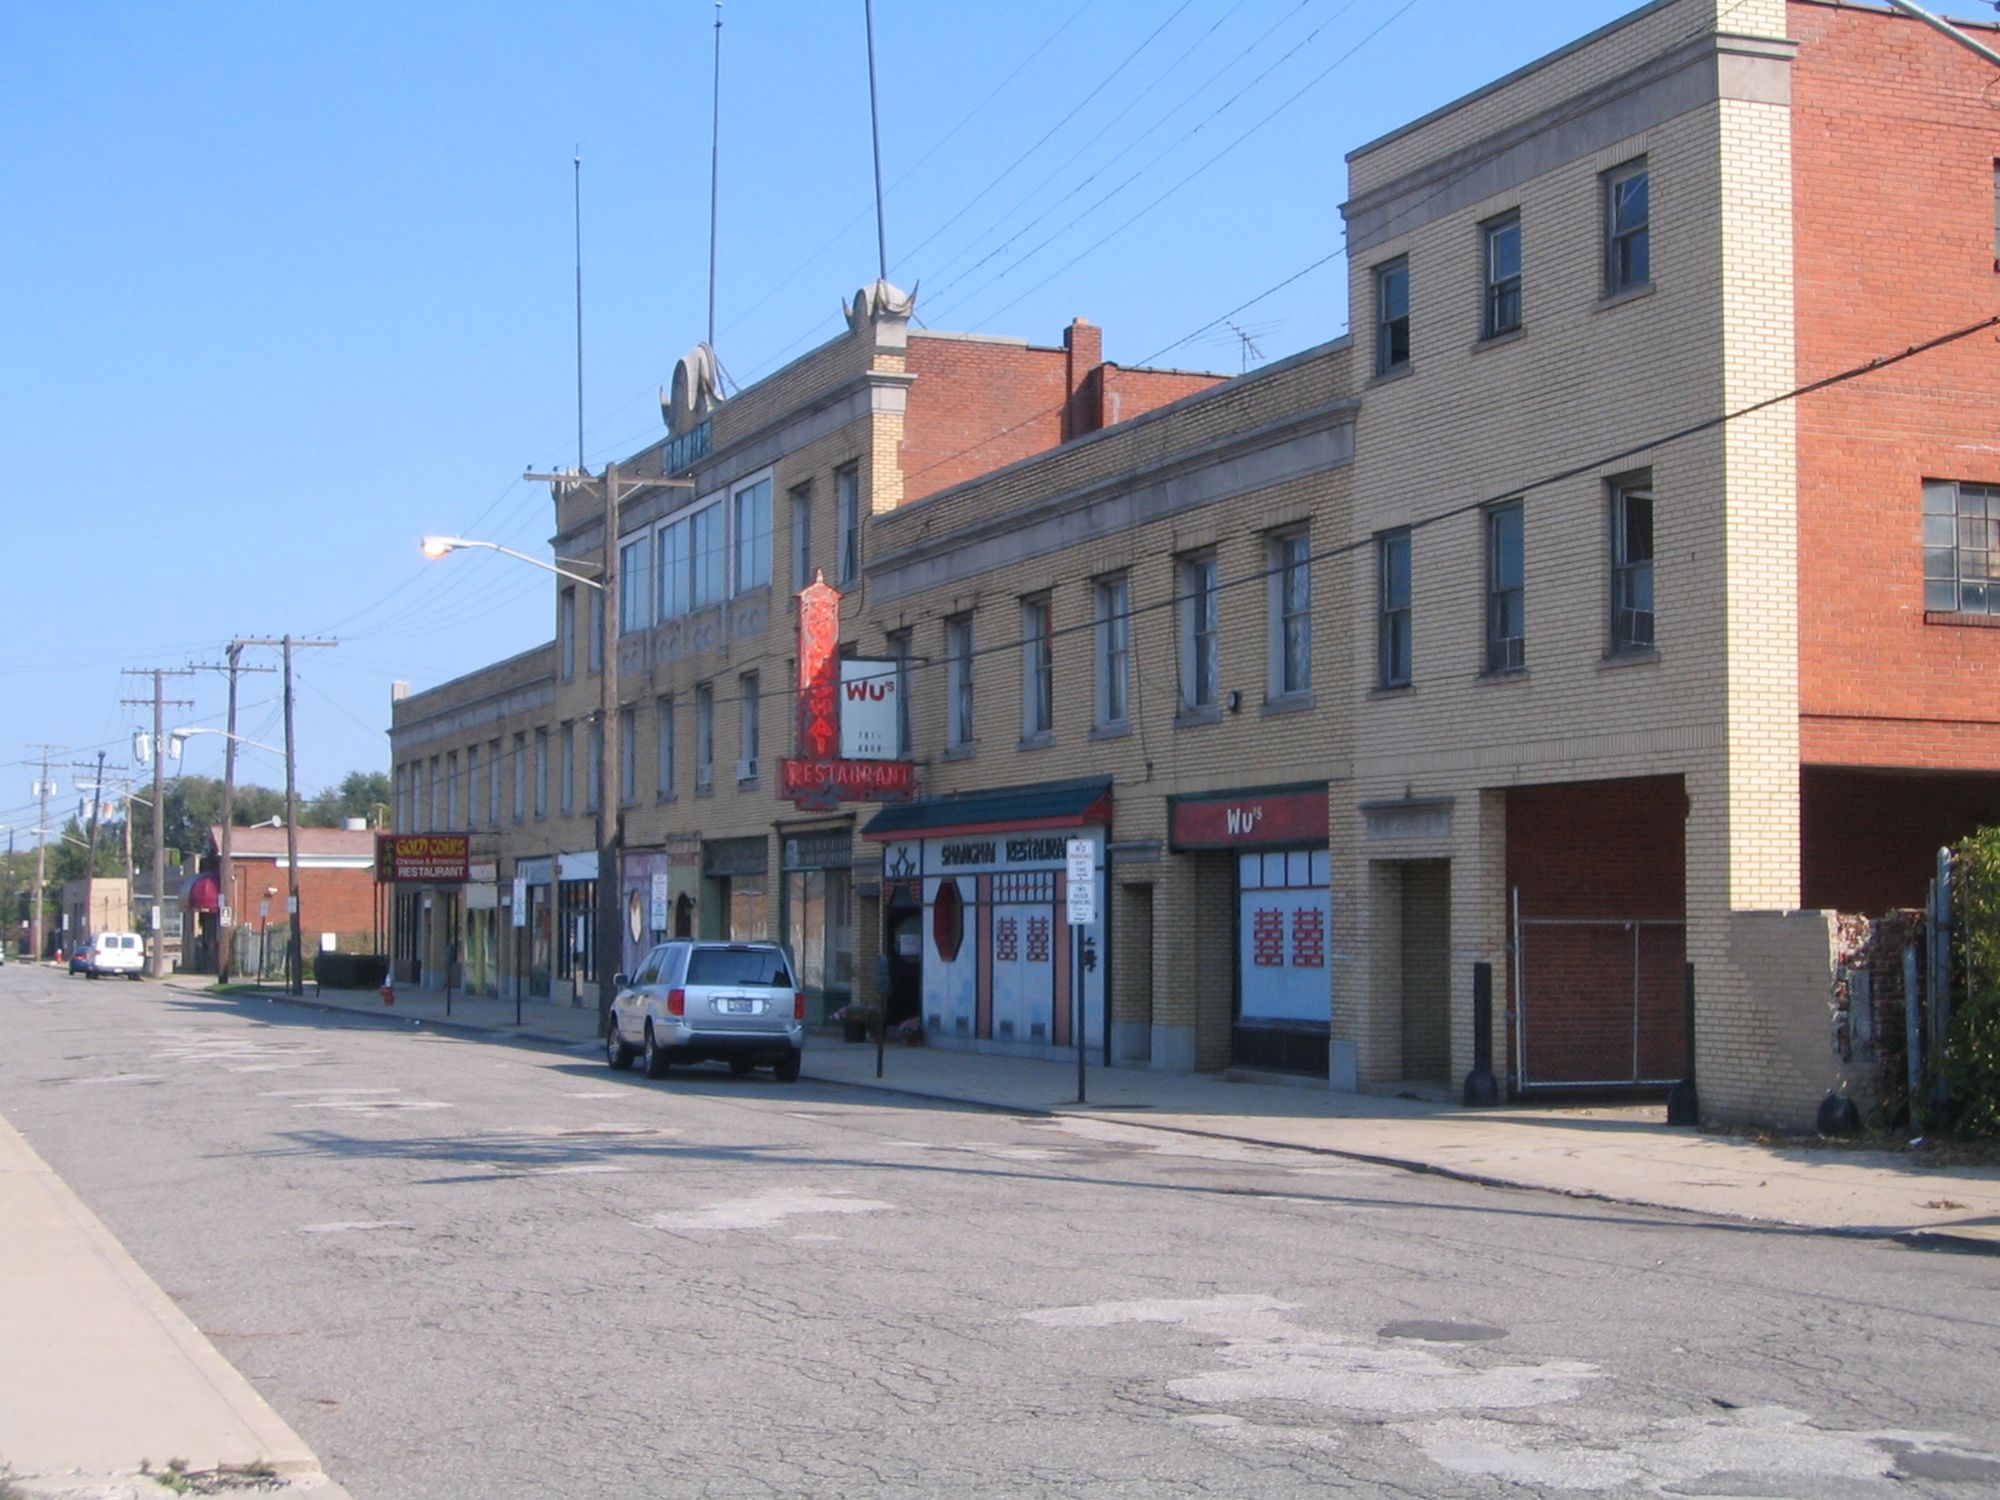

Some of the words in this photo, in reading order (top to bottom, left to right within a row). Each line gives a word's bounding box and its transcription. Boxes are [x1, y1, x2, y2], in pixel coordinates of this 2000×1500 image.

[787, 761, 908, 787] RESTAURANT
[941, 842, 996, 867] SHANGHAI
[1006, 834, 1078, 862] RESTAURA
[398, 867, 464, 877] RESTAURANT
